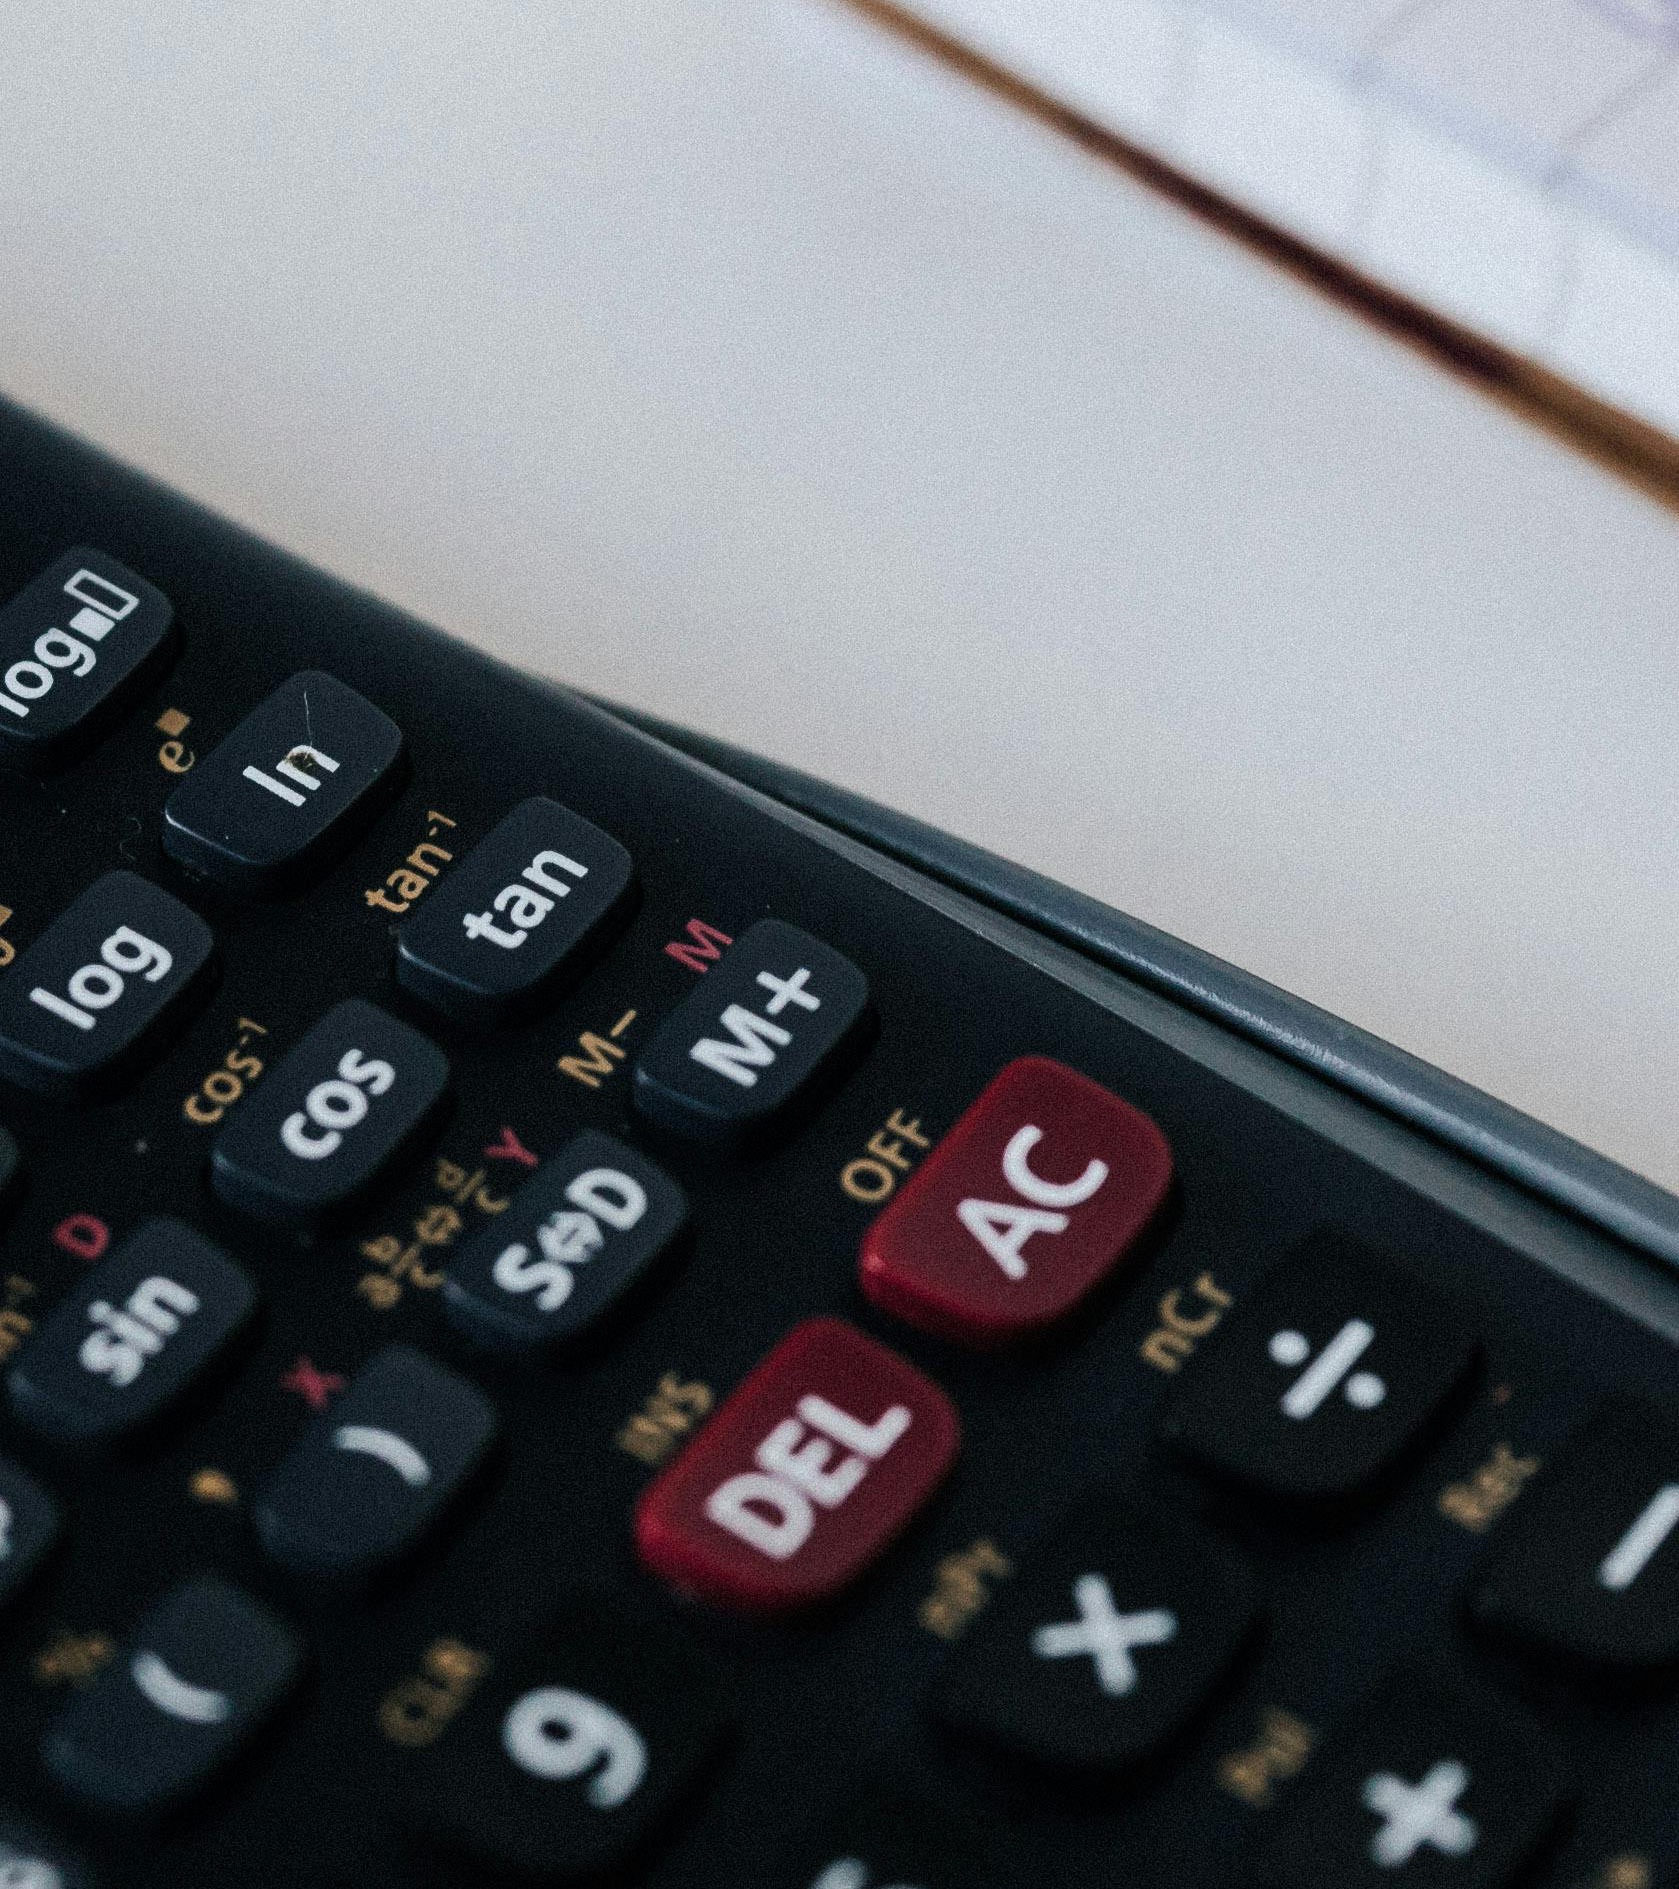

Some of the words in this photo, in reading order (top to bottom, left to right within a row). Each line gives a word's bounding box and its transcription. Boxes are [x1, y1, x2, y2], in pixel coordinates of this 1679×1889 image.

[462, 849, 588, 950] tan
[665, 918, 733, 973] M
[29, 925, 173, 1030] log
[690, 967, 821, 1087] M+
[280, 1048, 396, 1160] cos
[488, 1128, 537, 1166] Y
[840, 1110, 932, 1204] OFF
[957, 1125, 1108, 1279] AC
[55, 1214, 109, 1259] D
[80, 1276, 198, 1385] sin
[1141, 1274, 1231, 1371] nCr
[707, 1395, 910, 1558] DEL
[505, 1688, 645, 1804] 9
[1368, 1764, 1473, 1863] +
